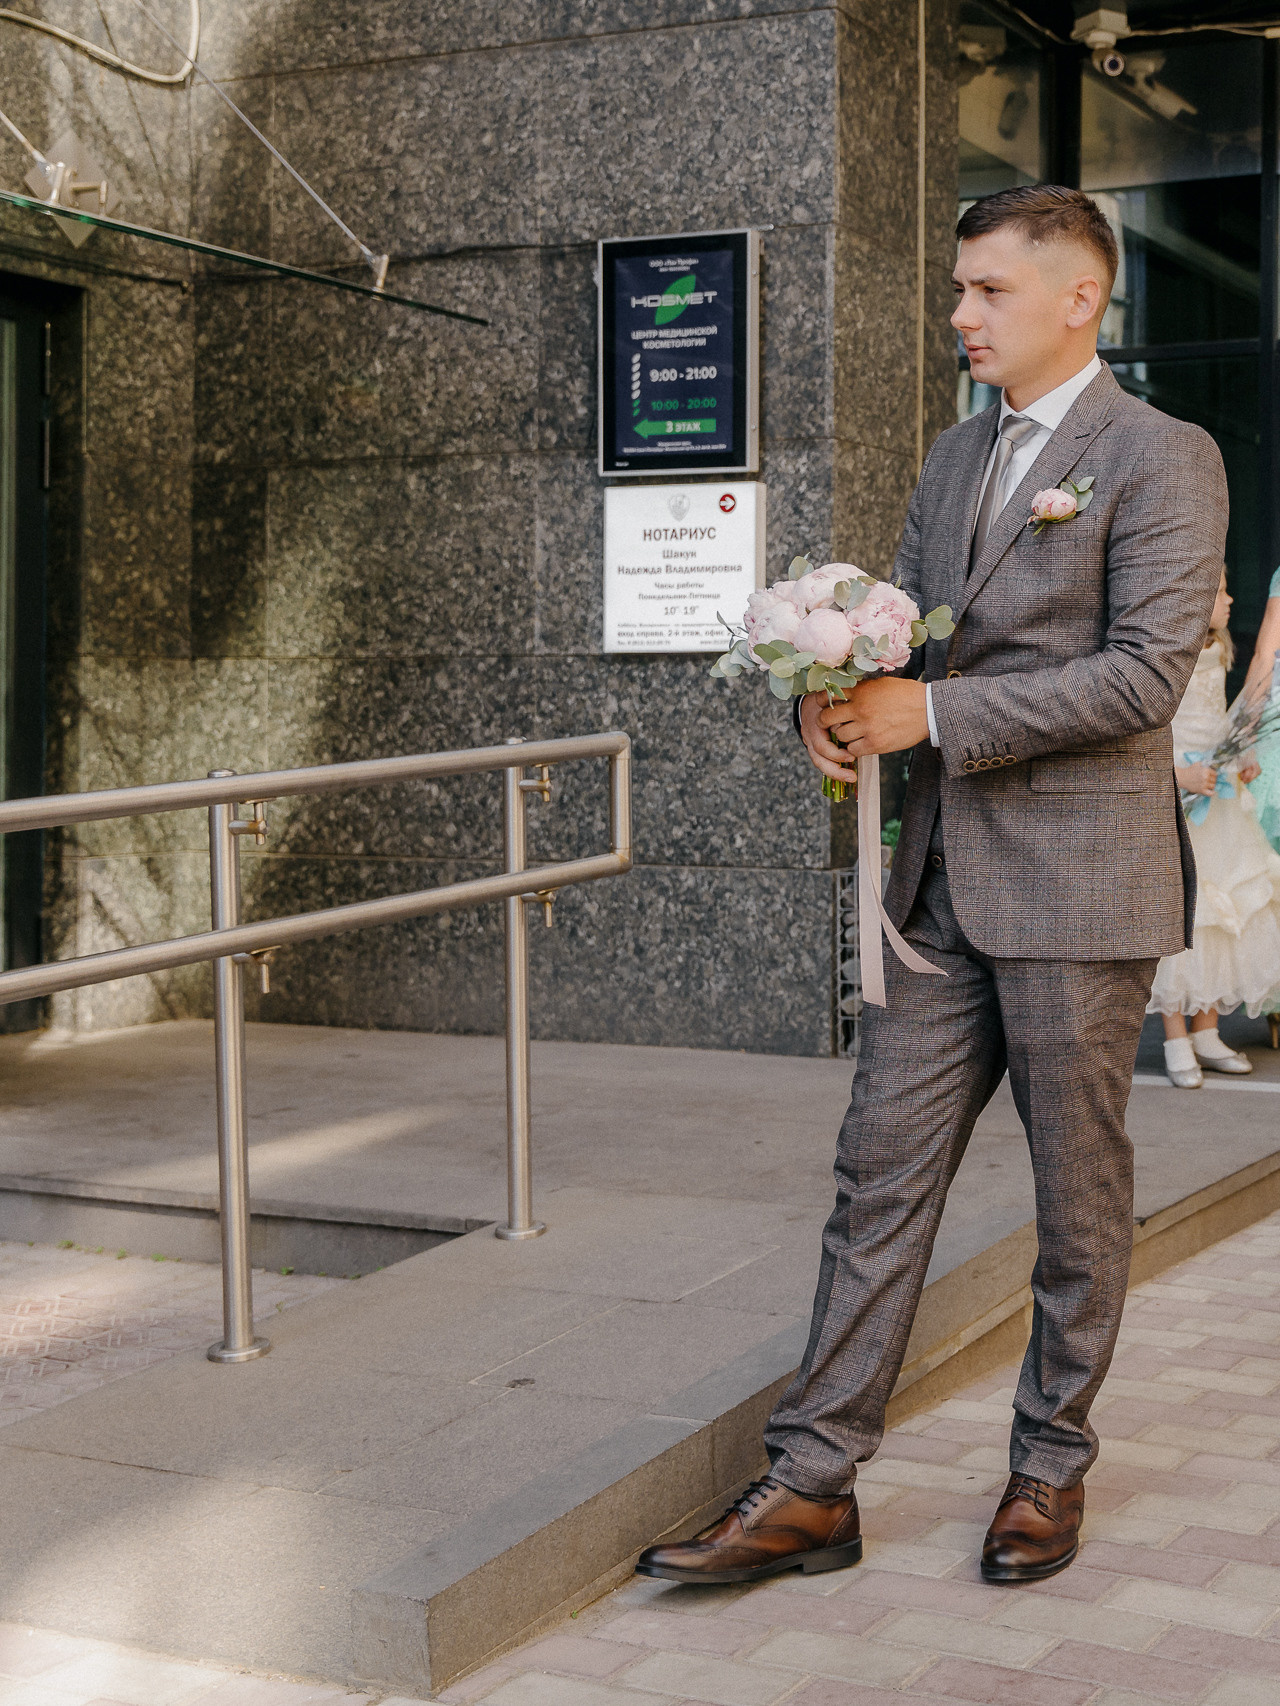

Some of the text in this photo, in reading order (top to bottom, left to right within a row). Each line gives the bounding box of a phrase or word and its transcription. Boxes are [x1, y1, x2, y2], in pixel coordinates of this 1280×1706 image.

[631, 325, 718, 340] ЦЕНТР МЕДИЦИНСКОЙ
[642, 337, 707, 350] КОСМЕТОЛОГИИ
[649, 368, 678, 382] 9:00
[685, 366, 718, 380] 21:00
[651, 399, 679, 411] 10:00
[687, 397, 717, 409] 20:00
[665, 420, 701, 433] 3 ЭТАЖ
[643, 527, 717, 541] НОТАРИУС
[617, 564, 743, 576] Надежда Владимировна
